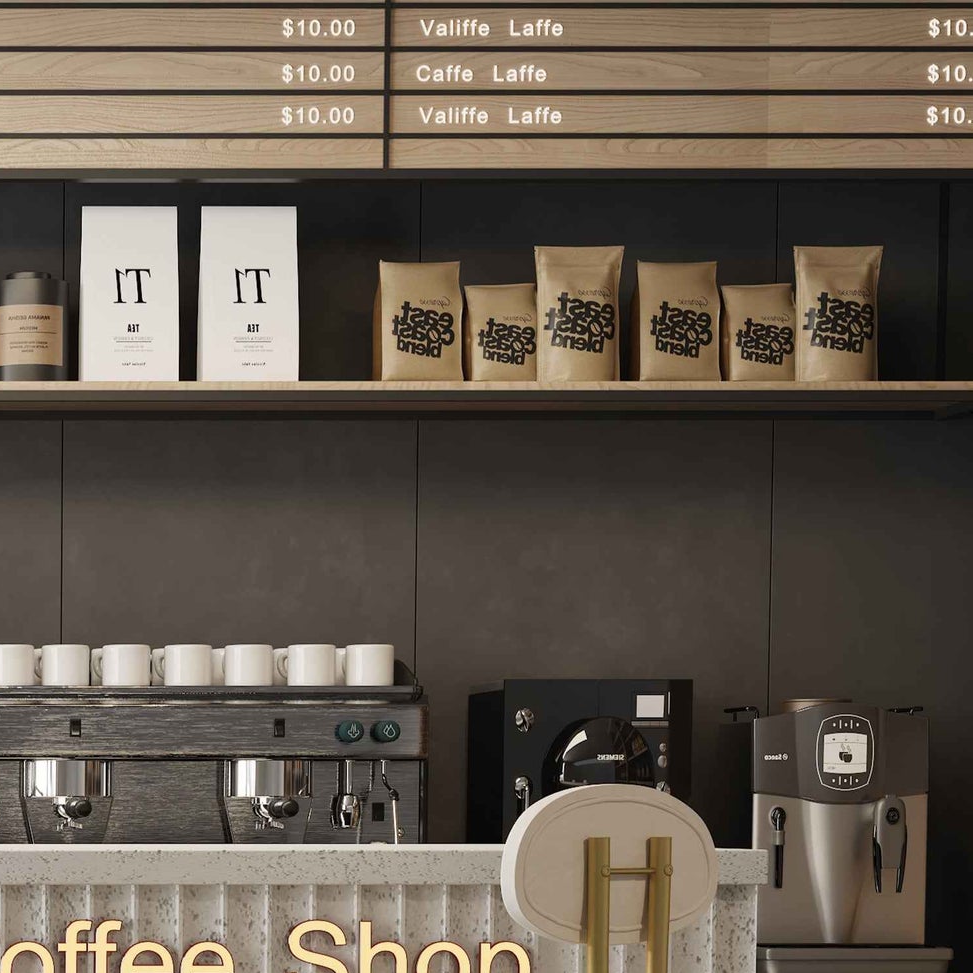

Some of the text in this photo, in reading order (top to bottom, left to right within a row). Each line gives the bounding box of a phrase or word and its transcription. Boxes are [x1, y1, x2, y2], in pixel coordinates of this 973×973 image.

[282, 18, 355, 38] $10.00
[420, 18, 563, 37] Valiffe Laffe
[282, 64, 354, 84] $10.00
[416, 64, 547, 83] Caffe Laffe
[281, 106, 354, 126] $10.00
[419, 106, 562, 124] Valiffe Laffe
